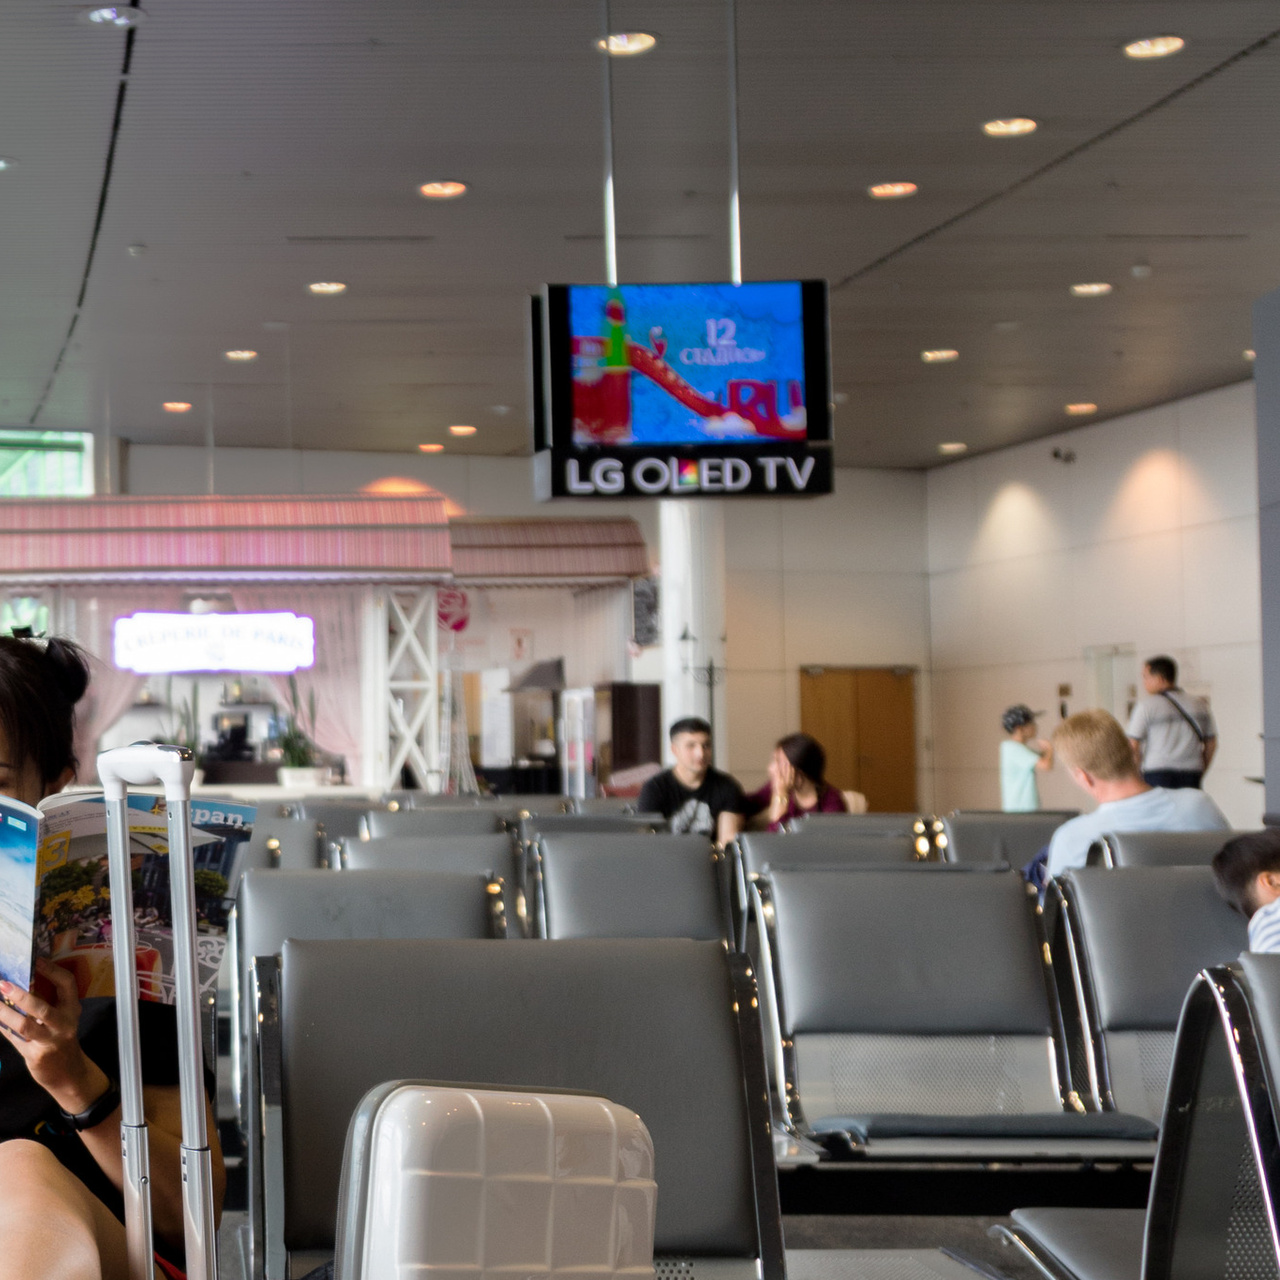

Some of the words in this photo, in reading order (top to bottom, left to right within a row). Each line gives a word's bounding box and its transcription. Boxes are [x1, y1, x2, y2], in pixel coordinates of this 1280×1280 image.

[706, 318, 737, 346] 12
[566, 457, 625, 495] LG
[632, 456, 752, 494] OLED
[757, 456, 816, 491] TV
[190, 807, 243, 827] pan
[46, 837, 67, 867] 3
